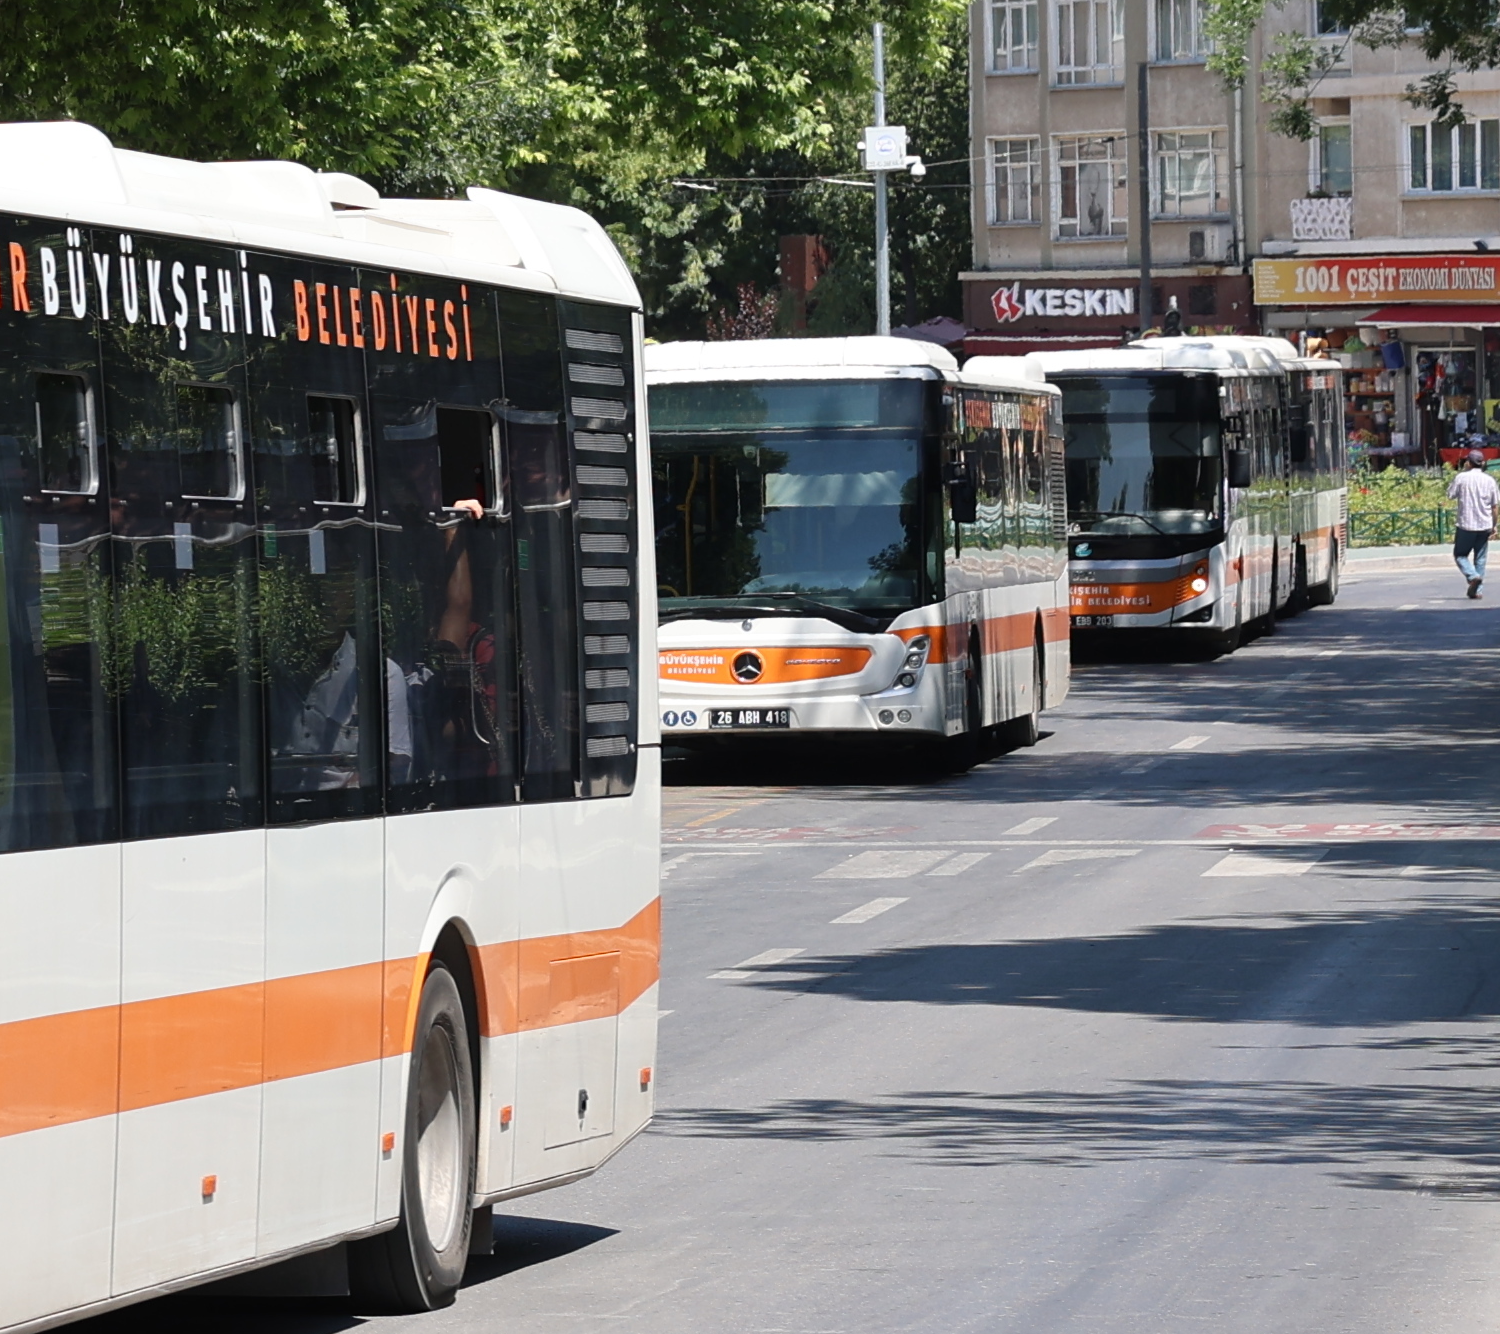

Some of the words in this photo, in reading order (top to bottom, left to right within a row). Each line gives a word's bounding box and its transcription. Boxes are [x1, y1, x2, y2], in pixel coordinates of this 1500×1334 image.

[41, 227, 277, 351] BÜYÜKŞEHİR
[293, 272, 474, 361] BELEDİYESİ
[1295, 265, 1340, 293] 1001
[1347, 262, 1396, 298] ÇEŞİT
[1398, 261, 1449, 290] EKONOMİ
[1451, 261, 1495, 290] DÜNYASI
[1025, 287, 1134, 316] KESKİN
[659, 653, 724, 666] BÜYÜKŞEHİR
[717, 711, 733, 724] 26
[739, 710, 760, 724] ABH
